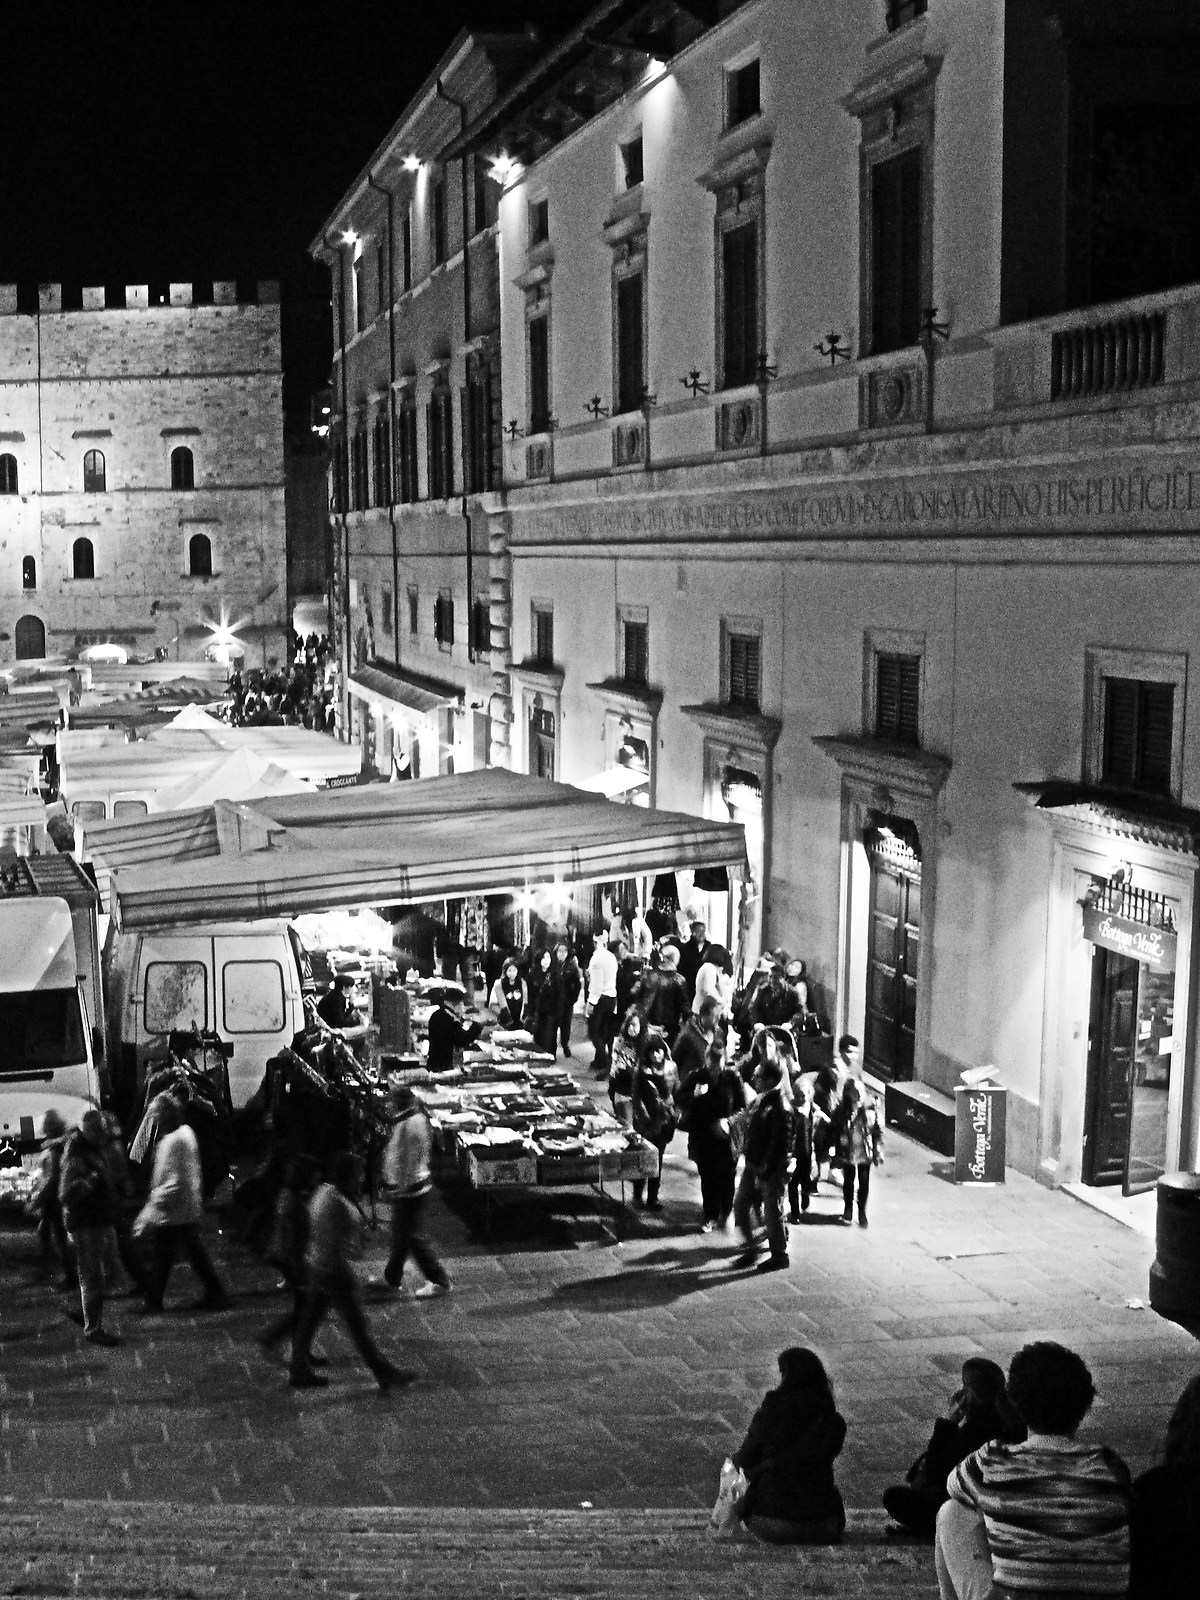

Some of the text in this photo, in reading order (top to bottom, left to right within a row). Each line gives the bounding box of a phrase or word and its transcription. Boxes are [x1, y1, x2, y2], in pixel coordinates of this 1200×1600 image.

[1098, 917, 1133, 951] Bottega
[1133, 932, 1164, 957] Verde
[968, 1092, 991, 1179] Bottega Verde
